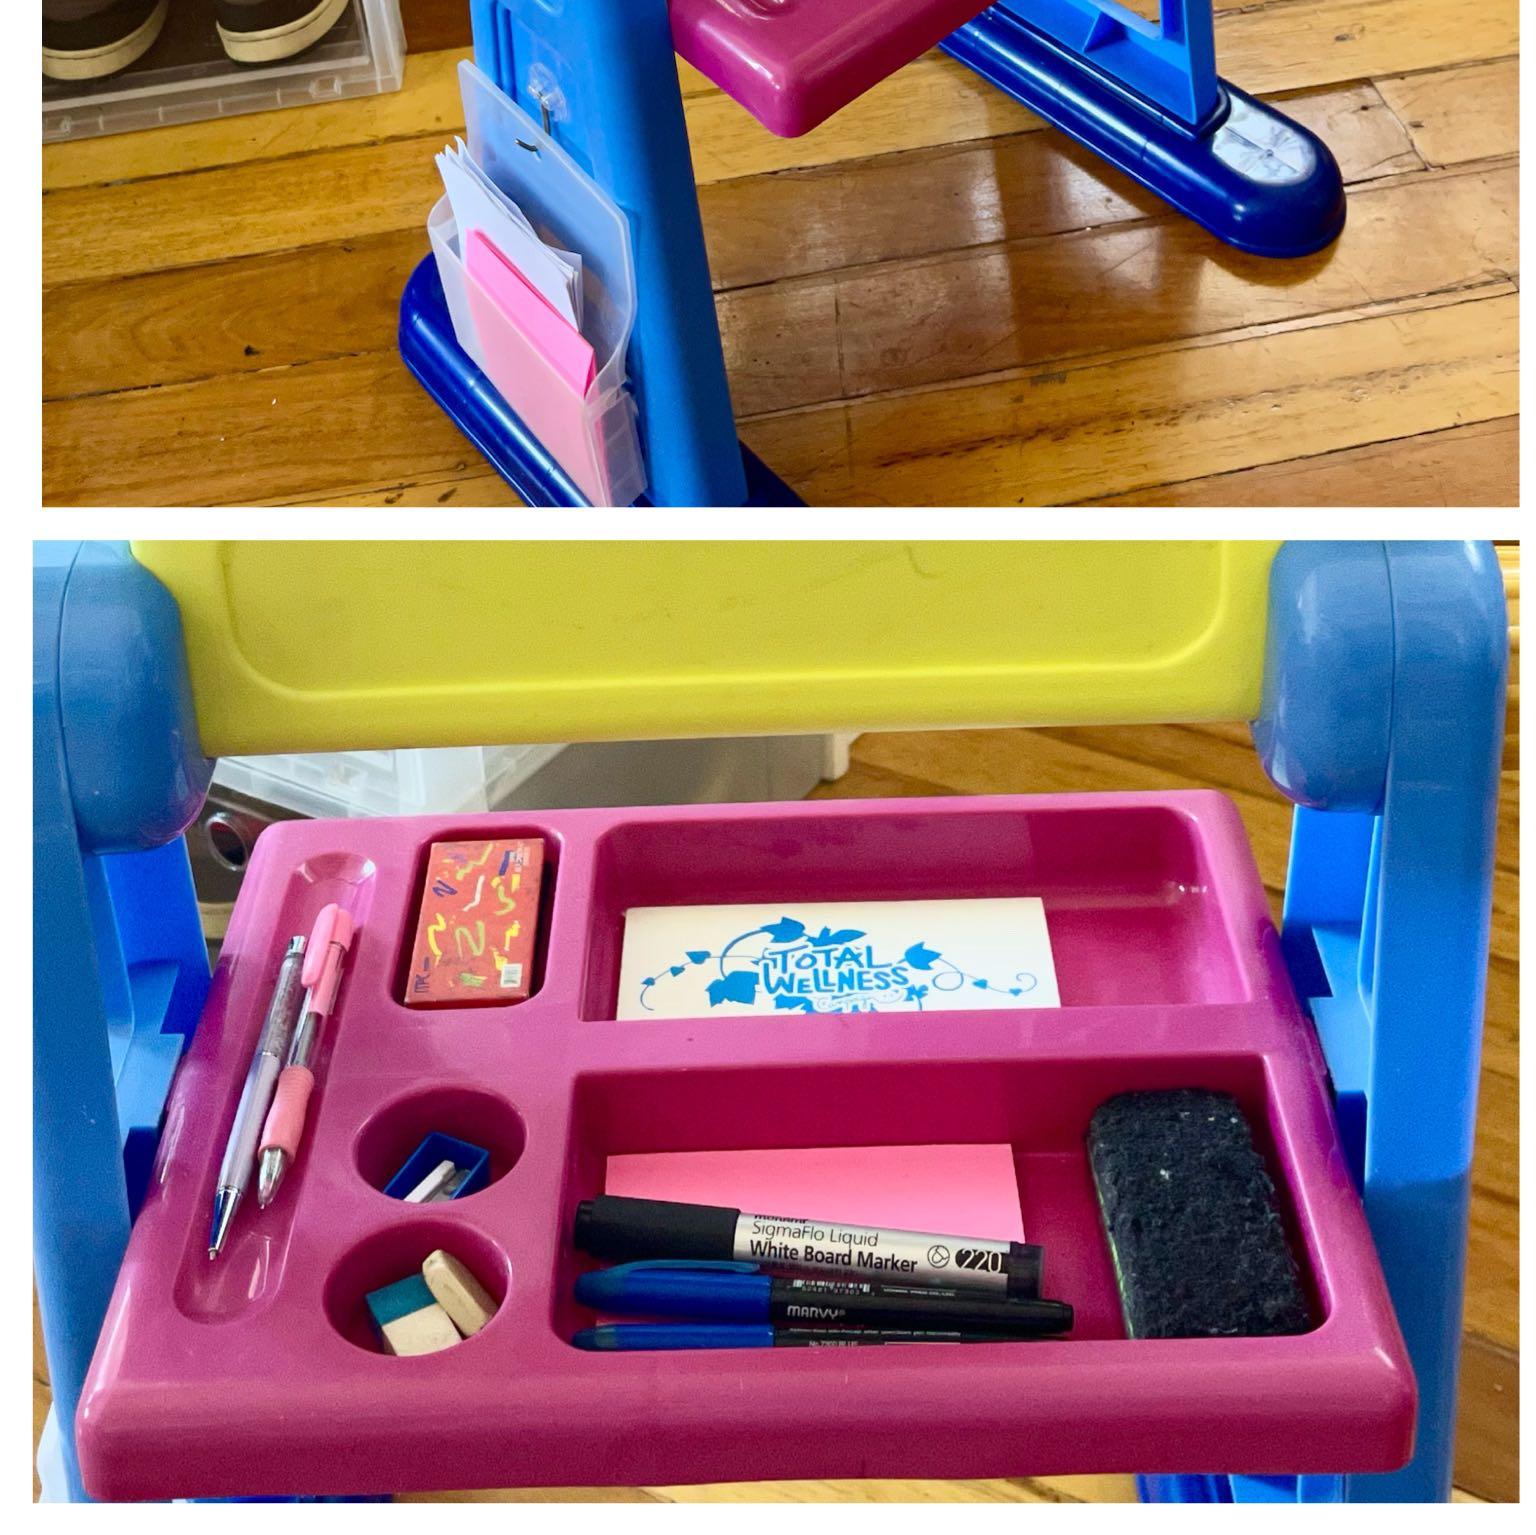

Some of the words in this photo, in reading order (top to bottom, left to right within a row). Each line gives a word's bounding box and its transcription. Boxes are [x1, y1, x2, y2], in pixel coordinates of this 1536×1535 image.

[768, 945, 893, 974] TOTAL
[763, 962, 909, 994] WELLNESS
[752, 1220, 824, 1241] SigmaFlo
[830, 1229, 879, 1247] Liquid
[750, 1239, 799, 1261] White
[804, 1245, 851, 1266] Board
[857, 1250, 918, 1273] Marker
[961, 1249, 1003, 1273] 220
[787, 1304, 839, 1320] MARVY
